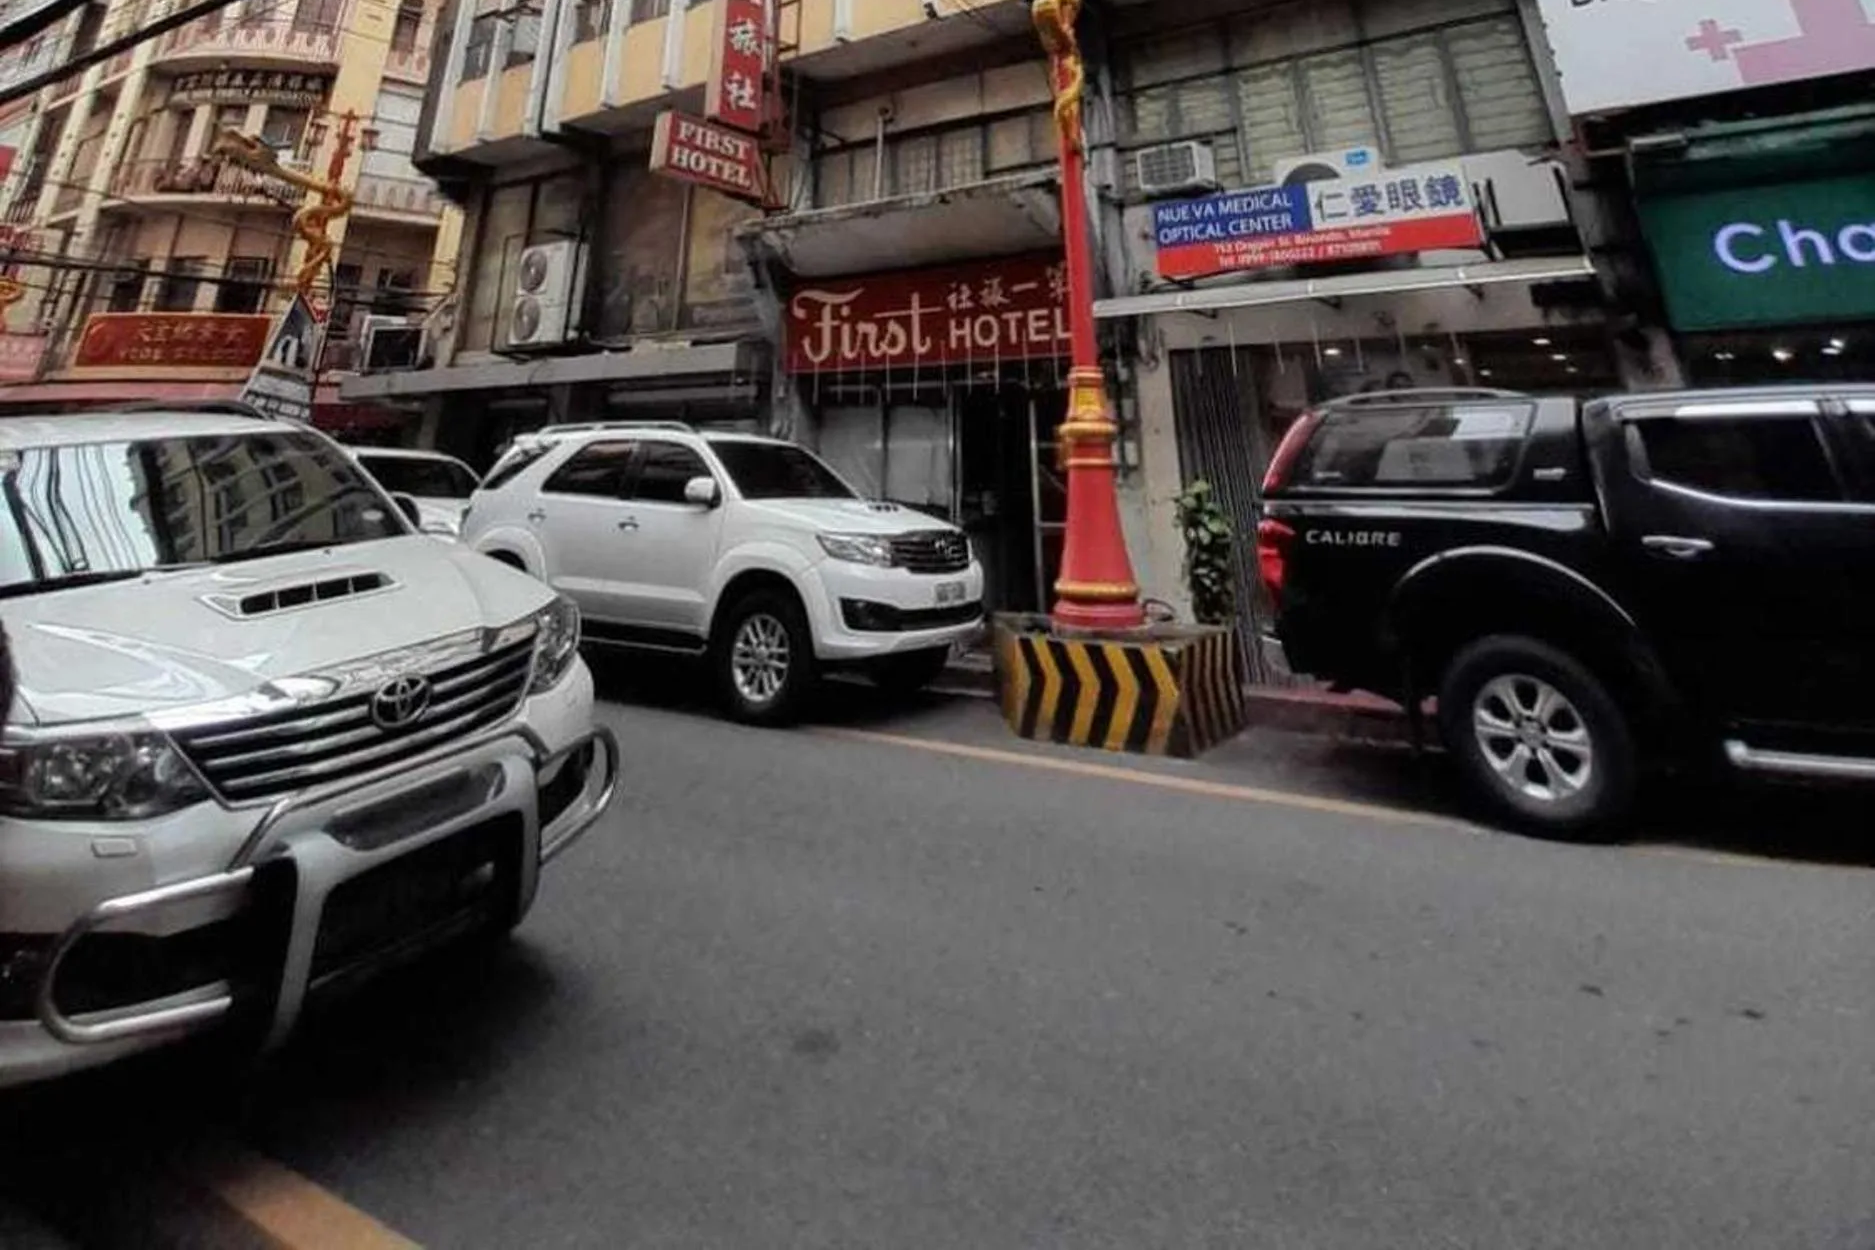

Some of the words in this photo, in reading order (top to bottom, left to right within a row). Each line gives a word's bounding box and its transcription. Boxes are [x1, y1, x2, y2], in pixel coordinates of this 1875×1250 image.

[679, 120, 751, 160] FIRST
[670, 146, 751, 187] HOTEL
[1157, 203, 1215, 224] NUEVA
[1218, 192, 1293, 215] MEDICAL
[1314, 173, 1465, 222] 仁愛眼鏡
[1159, 222, 1226, 244] OPTICAL
[1228, 212, 1293, 235] CENTER
[792, 286, 946, 363] First
[948, 307, 1073, 350] HOTEL
[1305, 528, 1402, 548] CALIBRE
